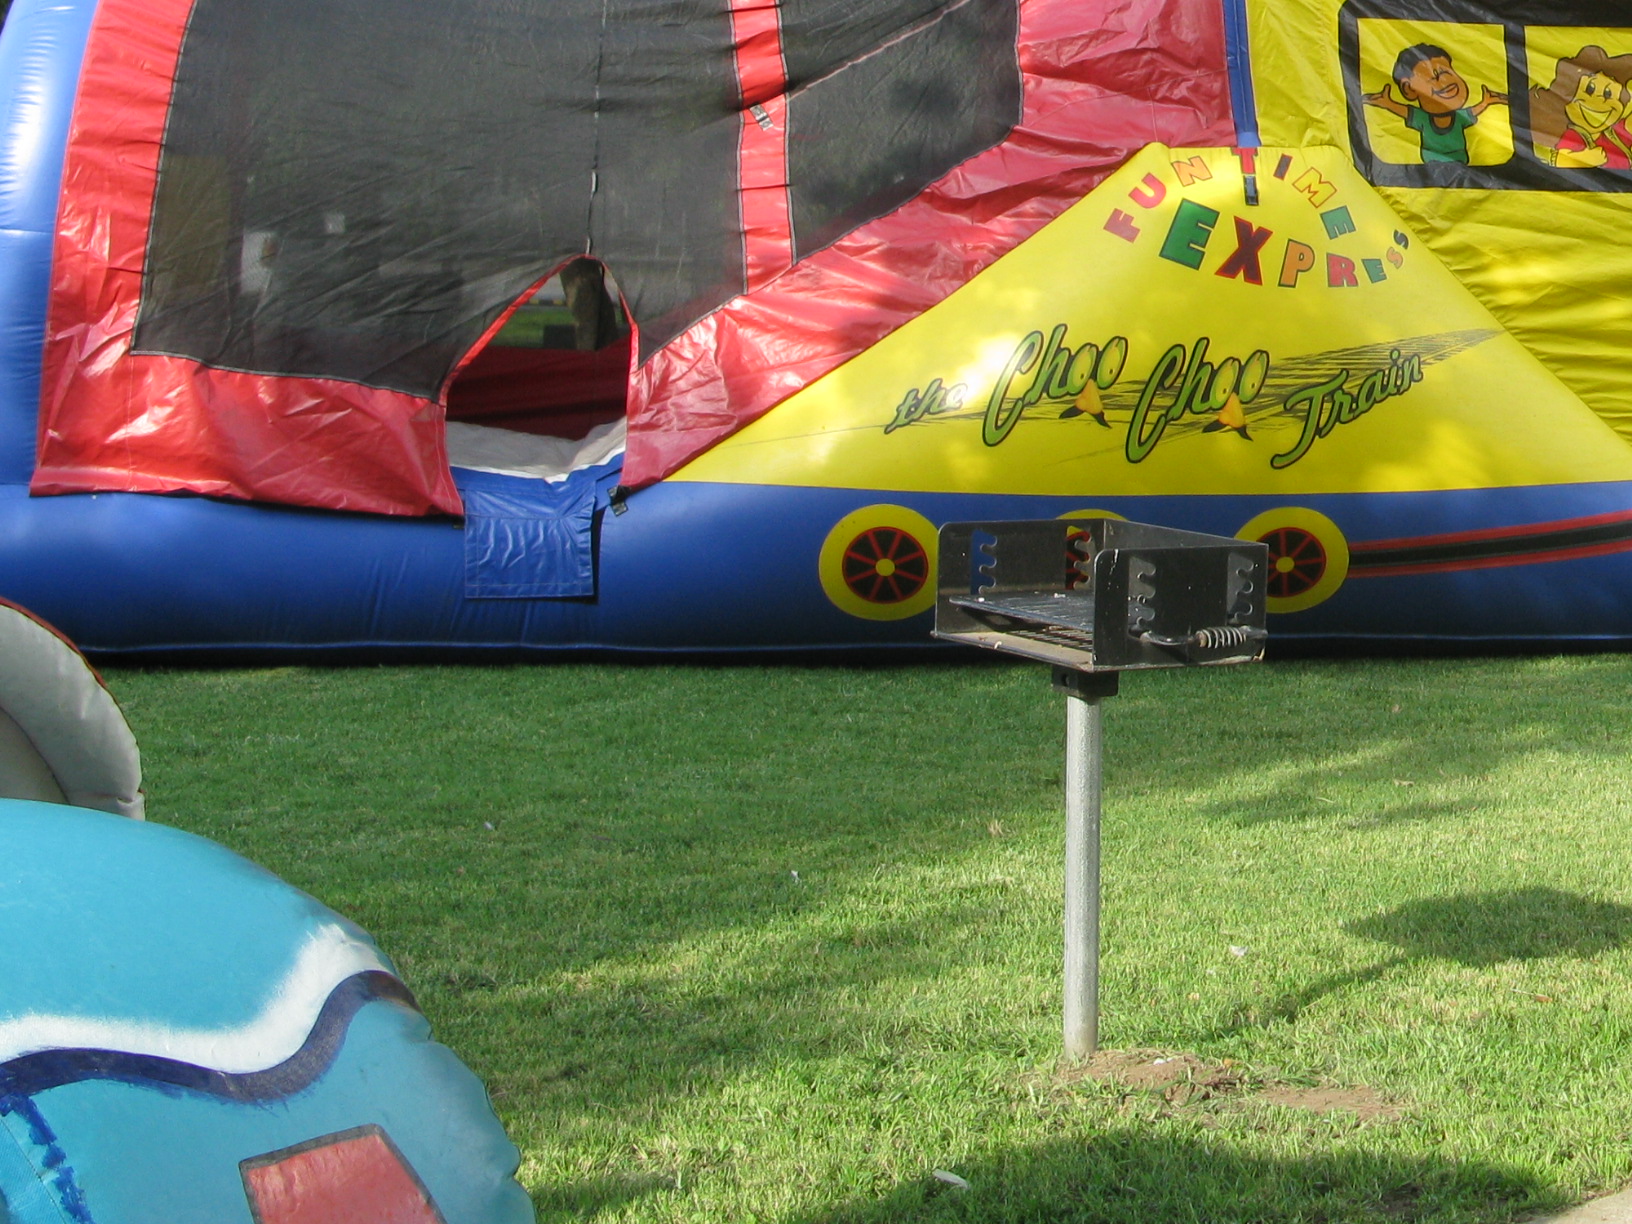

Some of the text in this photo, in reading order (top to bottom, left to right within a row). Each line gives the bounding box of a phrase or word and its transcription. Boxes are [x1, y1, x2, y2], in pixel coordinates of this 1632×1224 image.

[1158, 198, 1411, 288] EXPRESS
[884, 323, 1423, 470] the Choo Choo Train
